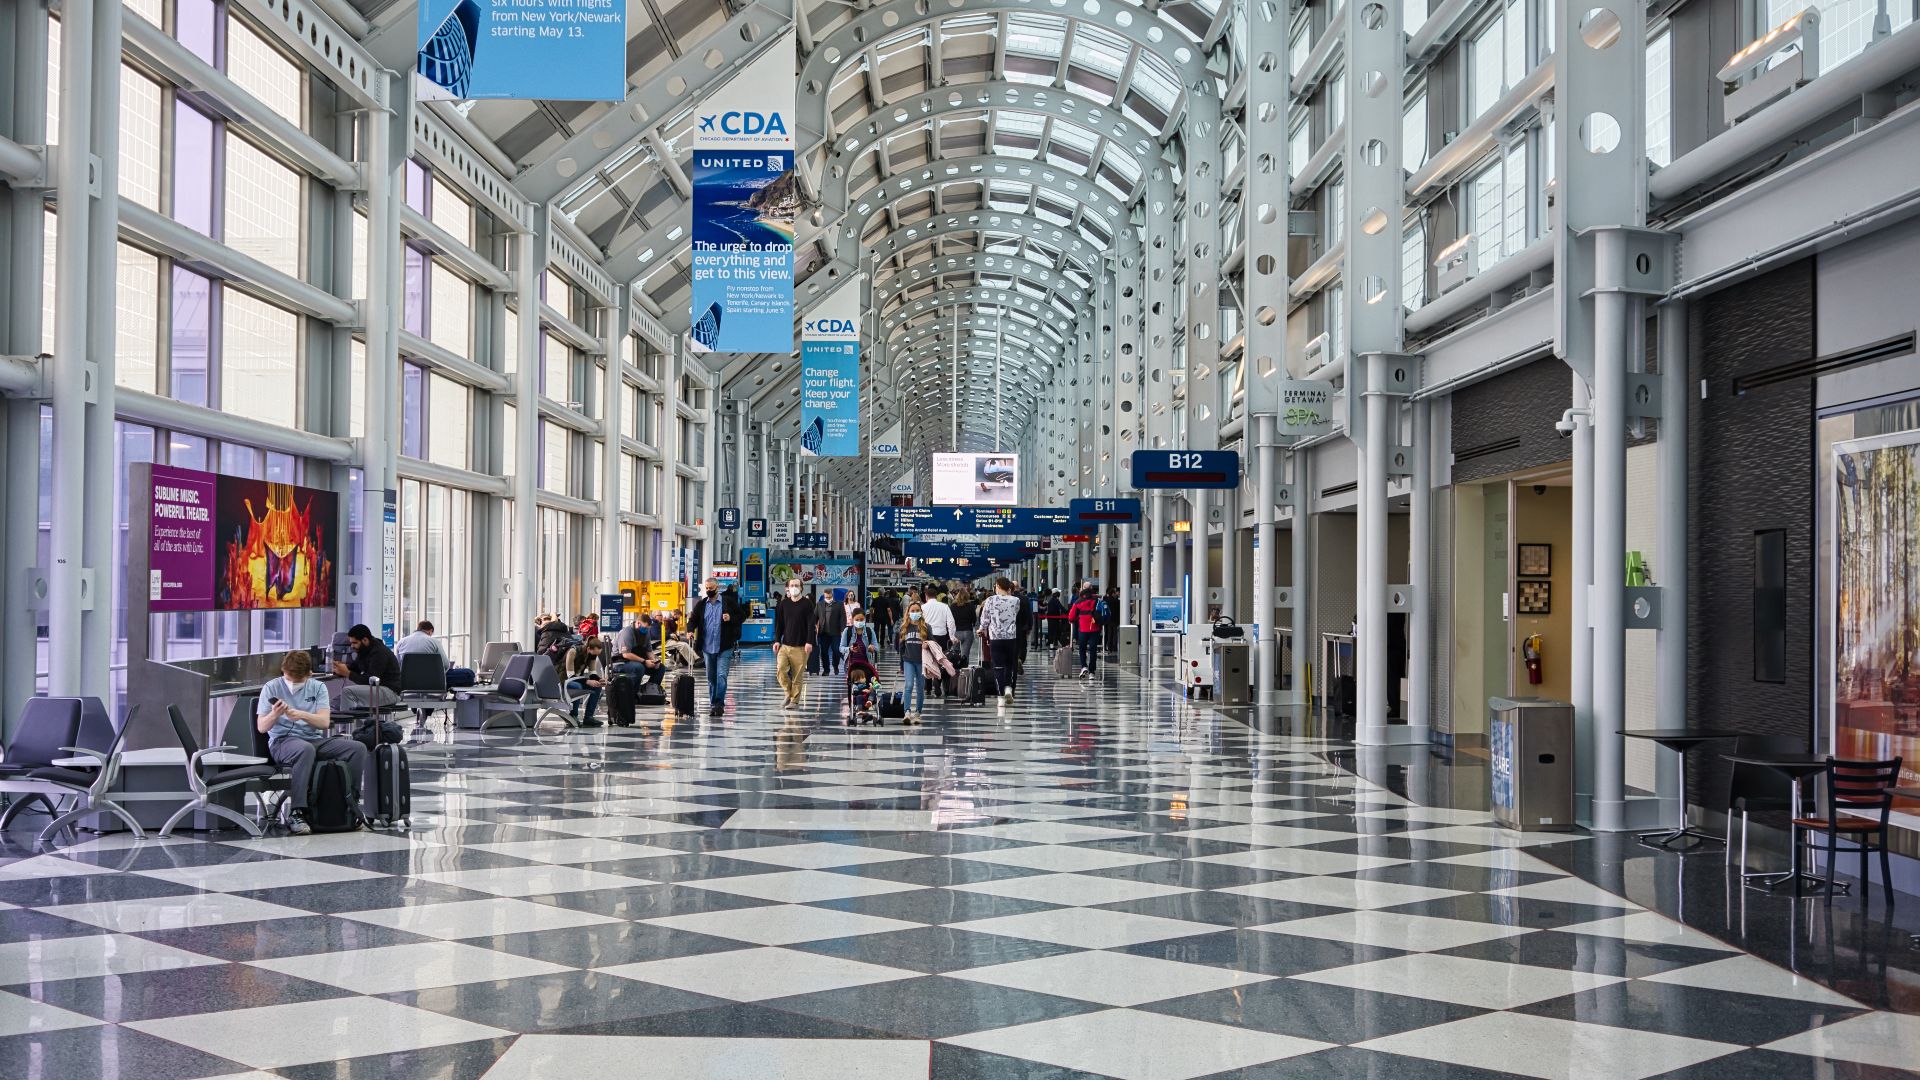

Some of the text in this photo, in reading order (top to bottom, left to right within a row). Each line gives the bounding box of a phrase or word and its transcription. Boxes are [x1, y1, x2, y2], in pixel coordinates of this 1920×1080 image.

[577, 0, 612, 9] flights
[492, 10, 621, 23] from New York/Newark
[491, 26, 585, 39] starting May 13.
[720, 111, 787, 135] CDA
[701, 158, 764, 168] UNITED
[694, 240, 793, 255] The urge to drop
[694, 254, 786, 267] everything and
[694, 267, 791, 280] get to this view.
[817, 319, 855, 333] CDA
[805, 367, 839, 378] Change
[805, 378, 856, 389] your flight.
[805, 389, 851, 400] Keep your
[804, 399, 838, 410] change.
[1286, 408, 1319, 426] SPA
[878, 444, 899, 452] CDA
[1169, 453, 1203, 469] B12
[154, 485, 200, 504] SUBLIME MUSIC.
[154, 502, 210, 522] POWERFUL THEATER.
[1095, 500, 1115, 511] B11
[154, 524, 202, 540] Experience the best of
[173, 543, 182, 552] arts
[182, 541, 192, 552] with
